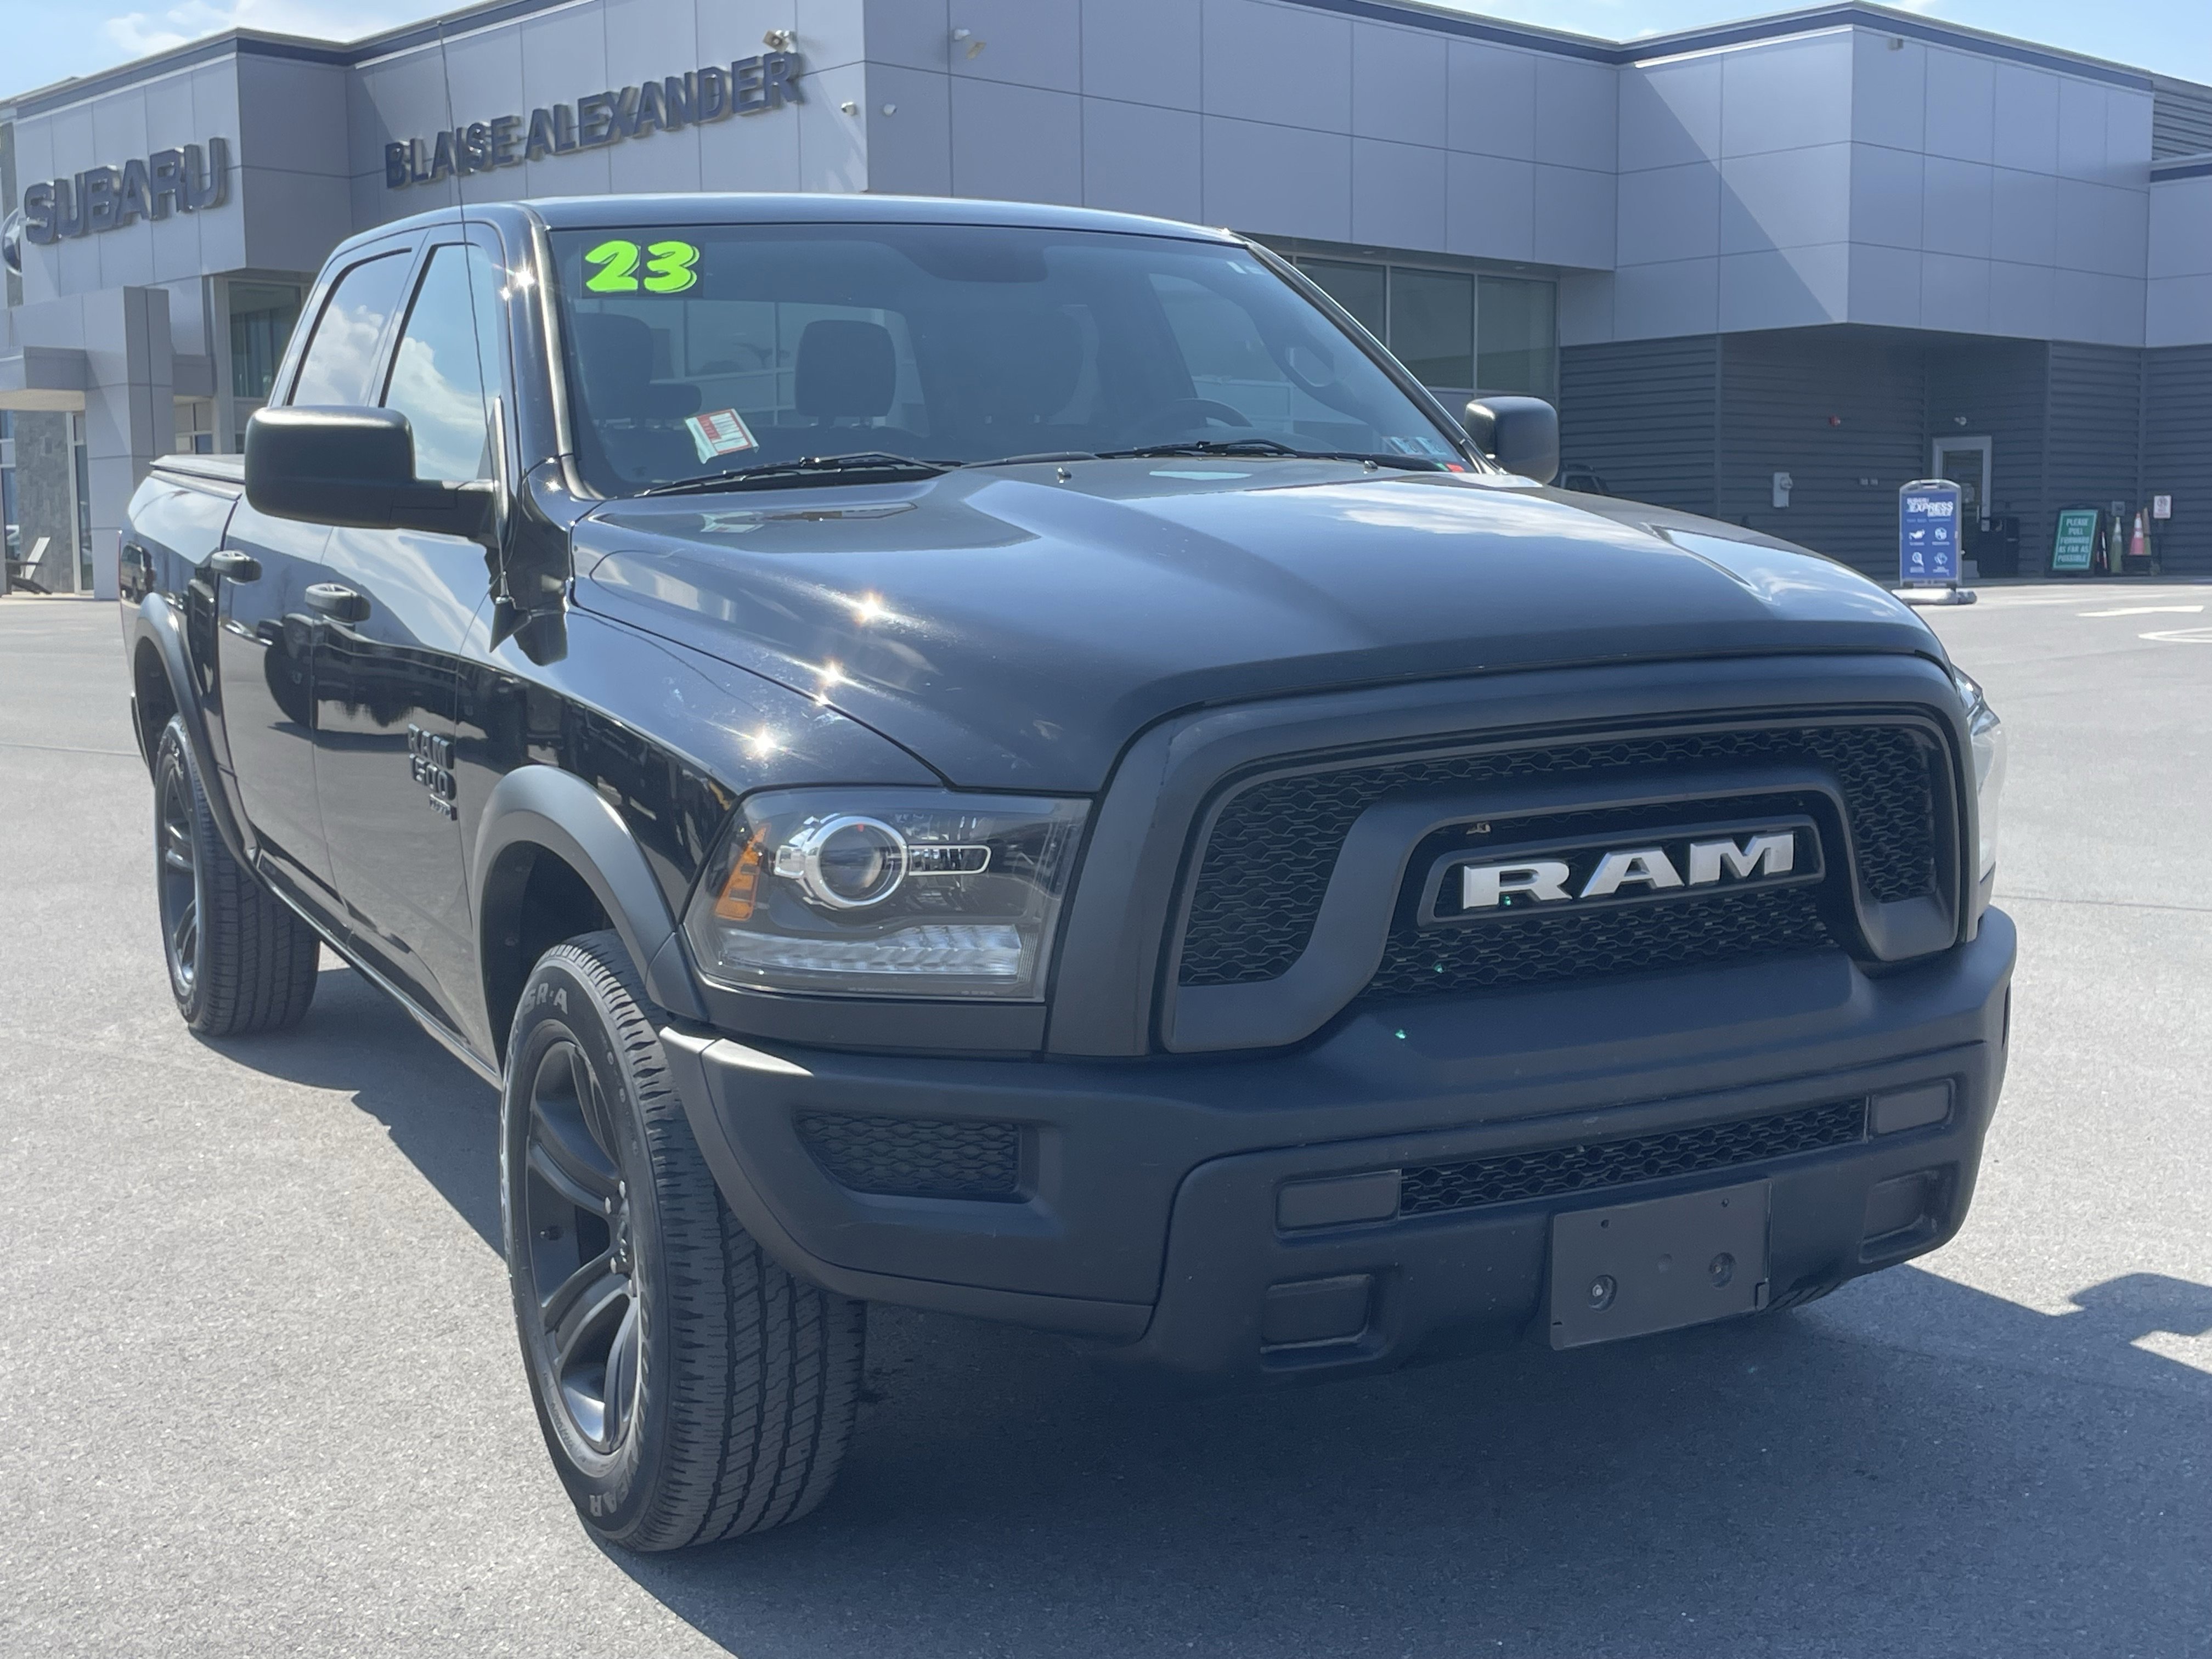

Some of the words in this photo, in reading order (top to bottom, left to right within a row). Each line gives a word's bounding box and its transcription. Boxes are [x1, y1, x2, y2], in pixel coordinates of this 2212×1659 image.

[385, 115, 524, 189] BLAISE
[524, 50, 804, 160] ALEXANDER
[24, 137, 227, 246] SUBARU
[584, 240, 700, 294] 23
[408, 723, 454, 770] RAM
[1463, 831, 1794, 909] RAM
